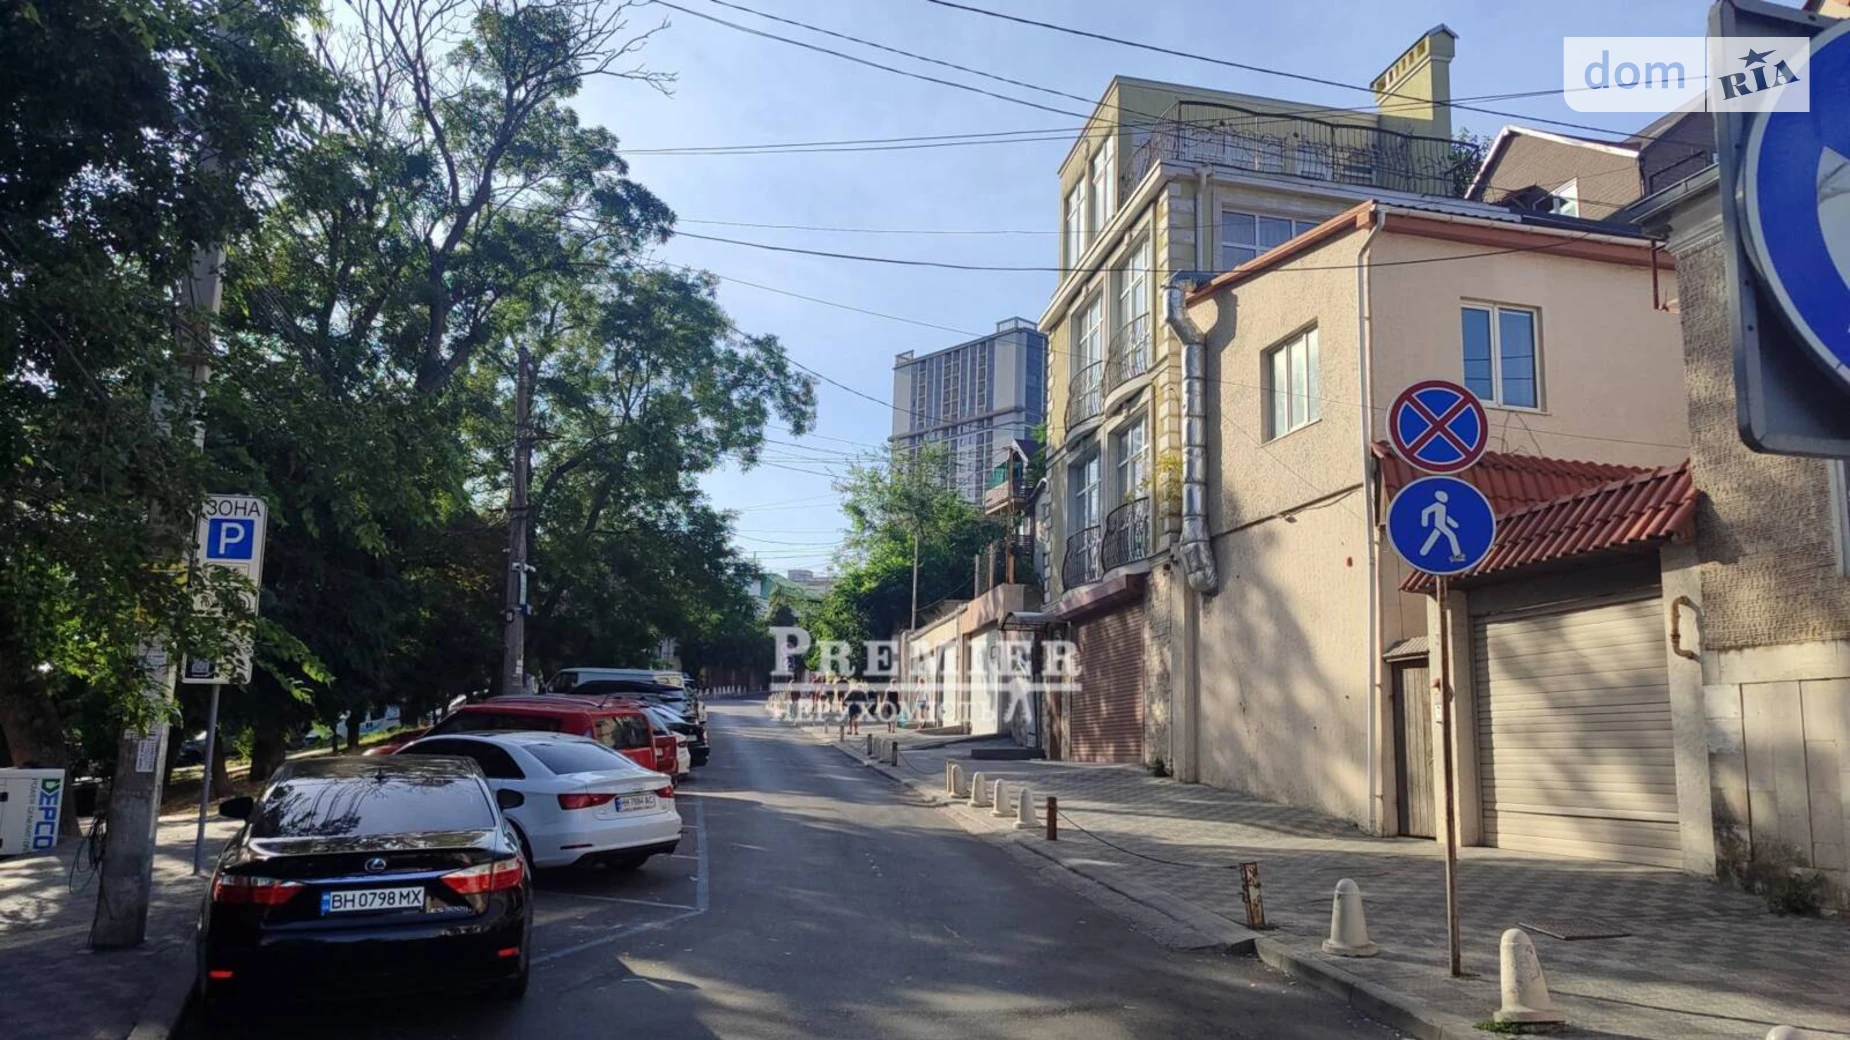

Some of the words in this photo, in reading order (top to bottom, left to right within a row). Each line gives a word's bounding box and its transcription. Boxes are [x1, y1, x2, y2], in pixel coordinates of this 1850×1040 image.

[207, 499, 261, 517] ЗОНА
[218, 522, 245, 555] P
[33, 778, 60, 850] DEPCO
[332, 893, 355, 909] BH
[358, 892, 396, 907] 0798
[399, 889, 422, 905] MX
